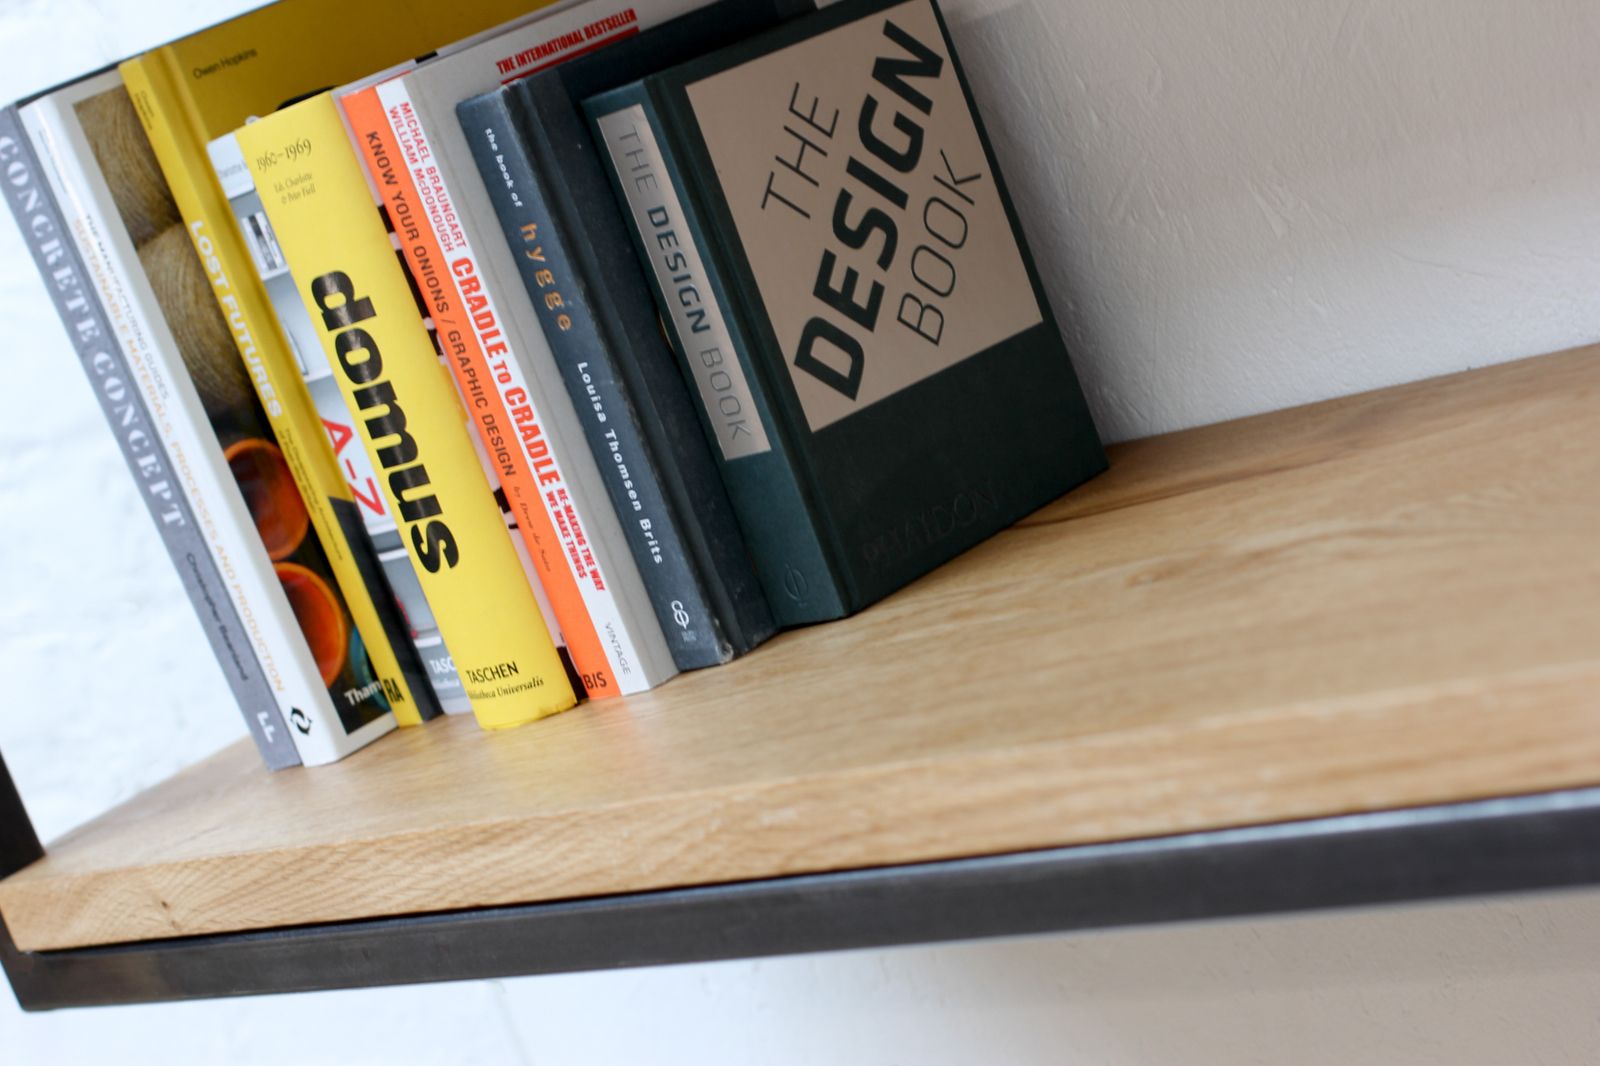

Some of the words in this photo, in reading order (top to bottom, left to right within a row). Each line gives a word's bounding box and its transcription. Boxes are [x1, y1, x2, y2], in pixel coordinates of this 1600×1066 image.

[192, 61, 220, 80] Owen
[219, 48, 258, 69] Hopkins
[496, 55, 516, 75] THE
[515, 28, 586, 67] INTERNATIONAL
[583, 8, 638, 41] BESTSELLER
[389, 105, 418, 165] WILLIAM
[413, 168, 454, 252] McDONOUGH
[401, 102, 431, 164] MICHAEL
[426, 166, 467, 248] BRAUNGART
[484, 127, 498, 151] the
[495, 154, 514, 189] book
[511, 192, 523, 208] of
[761, 82, 839, 219] THE
[793, 19, 945, 402] DESIGN
[98, 240, 148, 351] MANUFACTURING
[143, 352, 170, 400] GUIDES
[191, 220, 230, 290] LOST
[223, 293, 283, 418] FUTURES
[366, 131, 399, 187] KNOW
[392, 190, 420, 241] YOUR
[413, 245, 450, 314] ONIONS
[447, 329, 488, 409] GRAPHIC
[482, 414, 517, 477] DESIGN
[520, 222, 572, 331] hygge
[618, 124, 659, 194] THE
[646, 205, 711, 334] DESIGN
[700, 346, 752, 440] BOOK
[896, 148, 982, 346] BOOK
[0, 136, 100, 342] CONCRETE
[93, 352, 186, 527] CONCEPT
[452, 256, 508, 359] CRADLE
[494, 360, 512, 384] TO
[505, 387, 560, 486] CRADLE
[72, 217, 130, 334] SUSTAINABLE
[170, 441, 218, 541] PROCESSES
[216, 545, 237, 580] AND
[232, 583, 286, 693] PRODUCTION
[311, 270, 460, 574] domus
[577, 361, 607, 423] Louisa
[604, 428, 642, 511] Thomsen
[639, 518, 663, 565] Brits
[546, 491, 559, 509] WE
[554, 508, 571, 540] MAKE
[565, 538, 588, 580] THINGS
[557, 488, 588, 547] RE-MAKING
[581, 547, 596, 568] THE
[589, 567, 606, 592] WAY
[465, 660, 520, 685] TASCHEN
[496, 676, 544, 697] Universalis
[583, 671, 608, 691] BIS
[605, 622, 632, 676] VINTAGE
